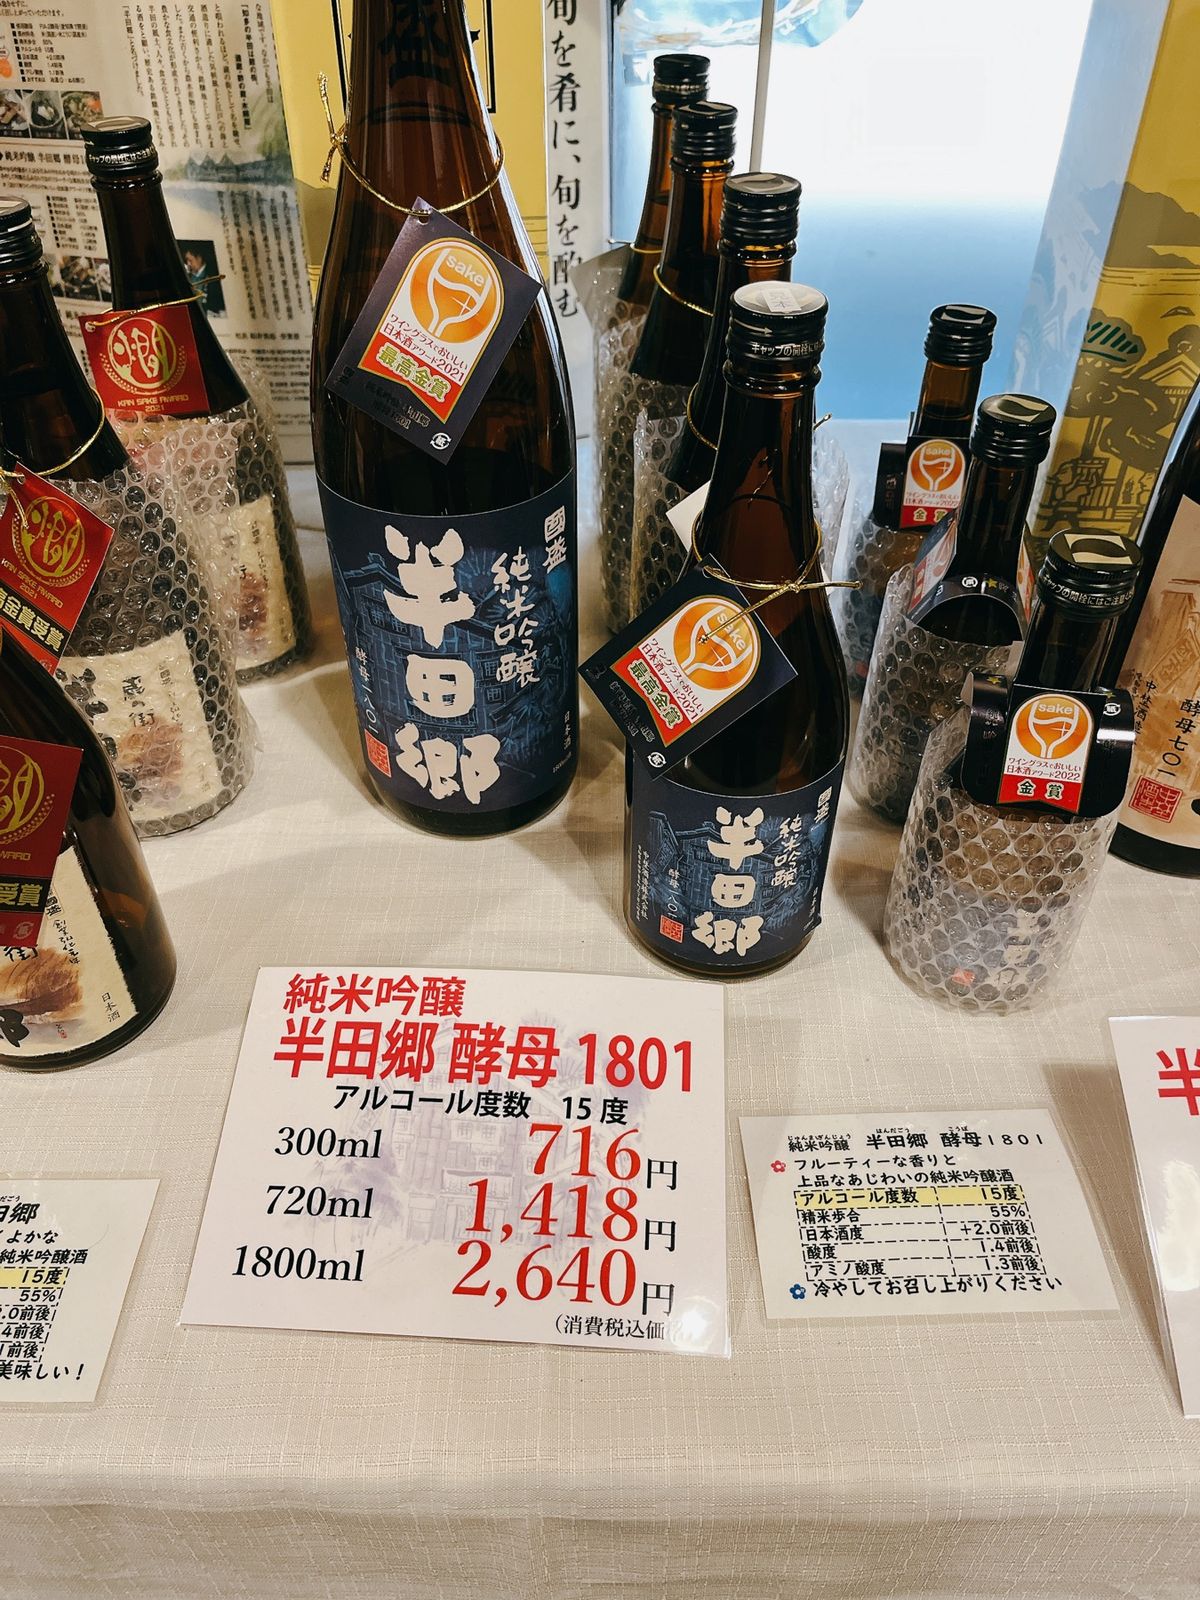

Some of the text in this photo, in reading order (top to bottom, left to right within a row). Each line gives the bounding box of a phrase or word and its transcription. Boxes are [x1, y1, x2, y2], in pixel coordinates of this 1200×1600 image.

[446, 254, 485, 288] sake
[384, 322, 465, 384] 日本酒アワード2021
[391, 313, 469, 369] ワイングラスでおいしい
[377, 343, 451, 401] 最高金賞
[117, 394, 189, 408] KAN SAKE AWARD
[1, 558, 65, 609] KAN SAKE AWARD
[18, 583, 39, 600] 2021
[491, 546, 541, 688] 純米吟醸
[383, 524, 502, 805] 半田郷
[641, 643, 699, 720] 日本酒アワード2021
[651, 637, 704, 713] ワイングラスでおいしい
[629, 661, 683, 727] 最高金賞
[1037, 702, 1075, 715] sake
[1006, 765, 1081, 782] 日本酒アワード2022
[1007, 757, 1081, 773] ワイングラスでおいしい
[771, 813, 802, 889] 純米吟醸
[691, 806, 766, 957] 半田郷
[101, 992, 121, 1023] 日本酒
[283, 973, 466, 1018] 純米吟醸
[273, 1018, 436, 1082] 半田郷
[577, 1031, 694, 1092] 1801
[333, 1084, 531, 1120] アルコール度数
[274, 1126, 383, 1160] 300ml
[788, 1139, 851, 1153] 純米吟醸
[866, 1132, 929, 1150] 半田郷
[793, 1153, 957, 1171] フルーティーな香りと
[797, 1168, 1015, 1188] 上品なあじわいの純米吟醸酒
[265, 1185, 373, 1220] 720ml
[799, 1186, 1021, 1207] アルコール度数 15度
[801, 1205, 1026, 1225] 精米歩合 55%
[805, 1221, 1031, 1242] 日本酒度 +2.0前後
[231, 1245, 365, 1283] 1800ml
[806, 1239, 1036, 1260] 酸度 1.4前後
[21, 1268, 65, 1286] 15度
[810, 1257, 1041, 1277] アミノ酸度 1.3前後
[19, 1289, 56, 1302] 55%
[813, 1275, 1063, 1298] 冷やしてお召し上がりください
